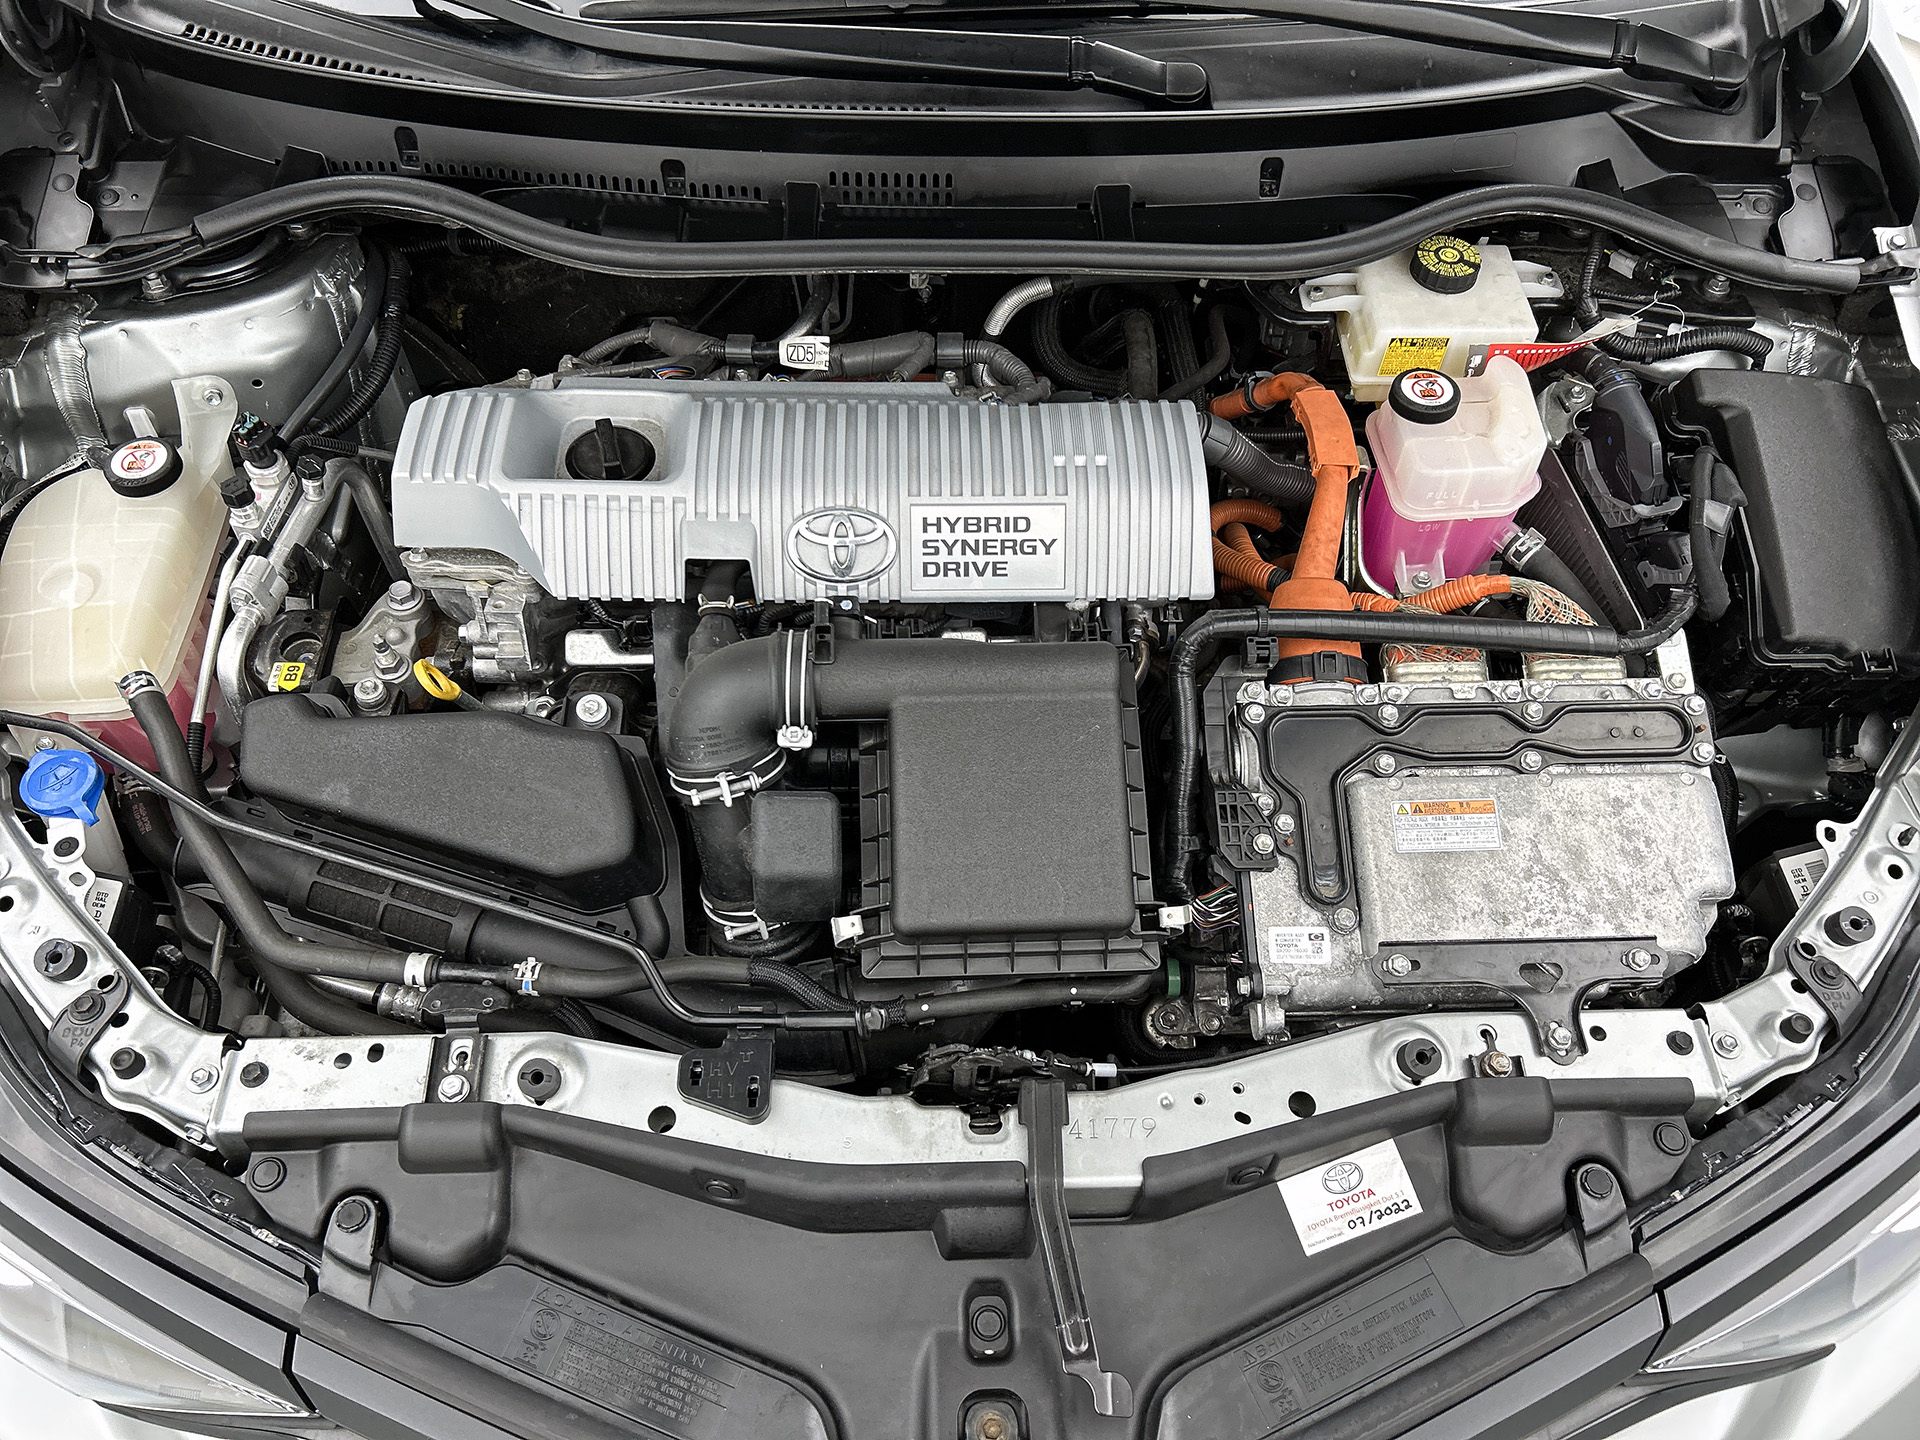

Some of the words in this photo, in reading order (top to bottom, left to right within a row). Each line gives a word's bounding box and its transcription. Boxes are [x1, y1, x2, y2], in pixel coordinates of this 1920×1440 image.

[789, 345, 814, 361] ZD5
[1426, 491, 1457, 499] FULL
[922, 516, 1031, 533] HYBRID
[1418, 523, 1441, 532] LOW
[922, 538, 1058, 556] SYNERGY
[922, 561, 1008, 577] DRIVE
[284, 665, 301, 682] B9
[709, 1061, 739, 1076] HV
[1068, 1117, 1157, 1140] 41779
[1327, 1188, 1376, 1212] TOYOTA
[1306, 1216, 1334, 1232] TOYOTA
[1333, 1198, 1383, 1222] Bremsflüssigkeit
[1381, 1194, 1396, 1204] Dot
[1395, 1189, 1406, 1199] 5.1
[1347, 1198, 1413, 1231] 07/2022
[551, 1292, 617, 1330] CAUTION
[620, 1322, 707, 1369] ATTENTION
